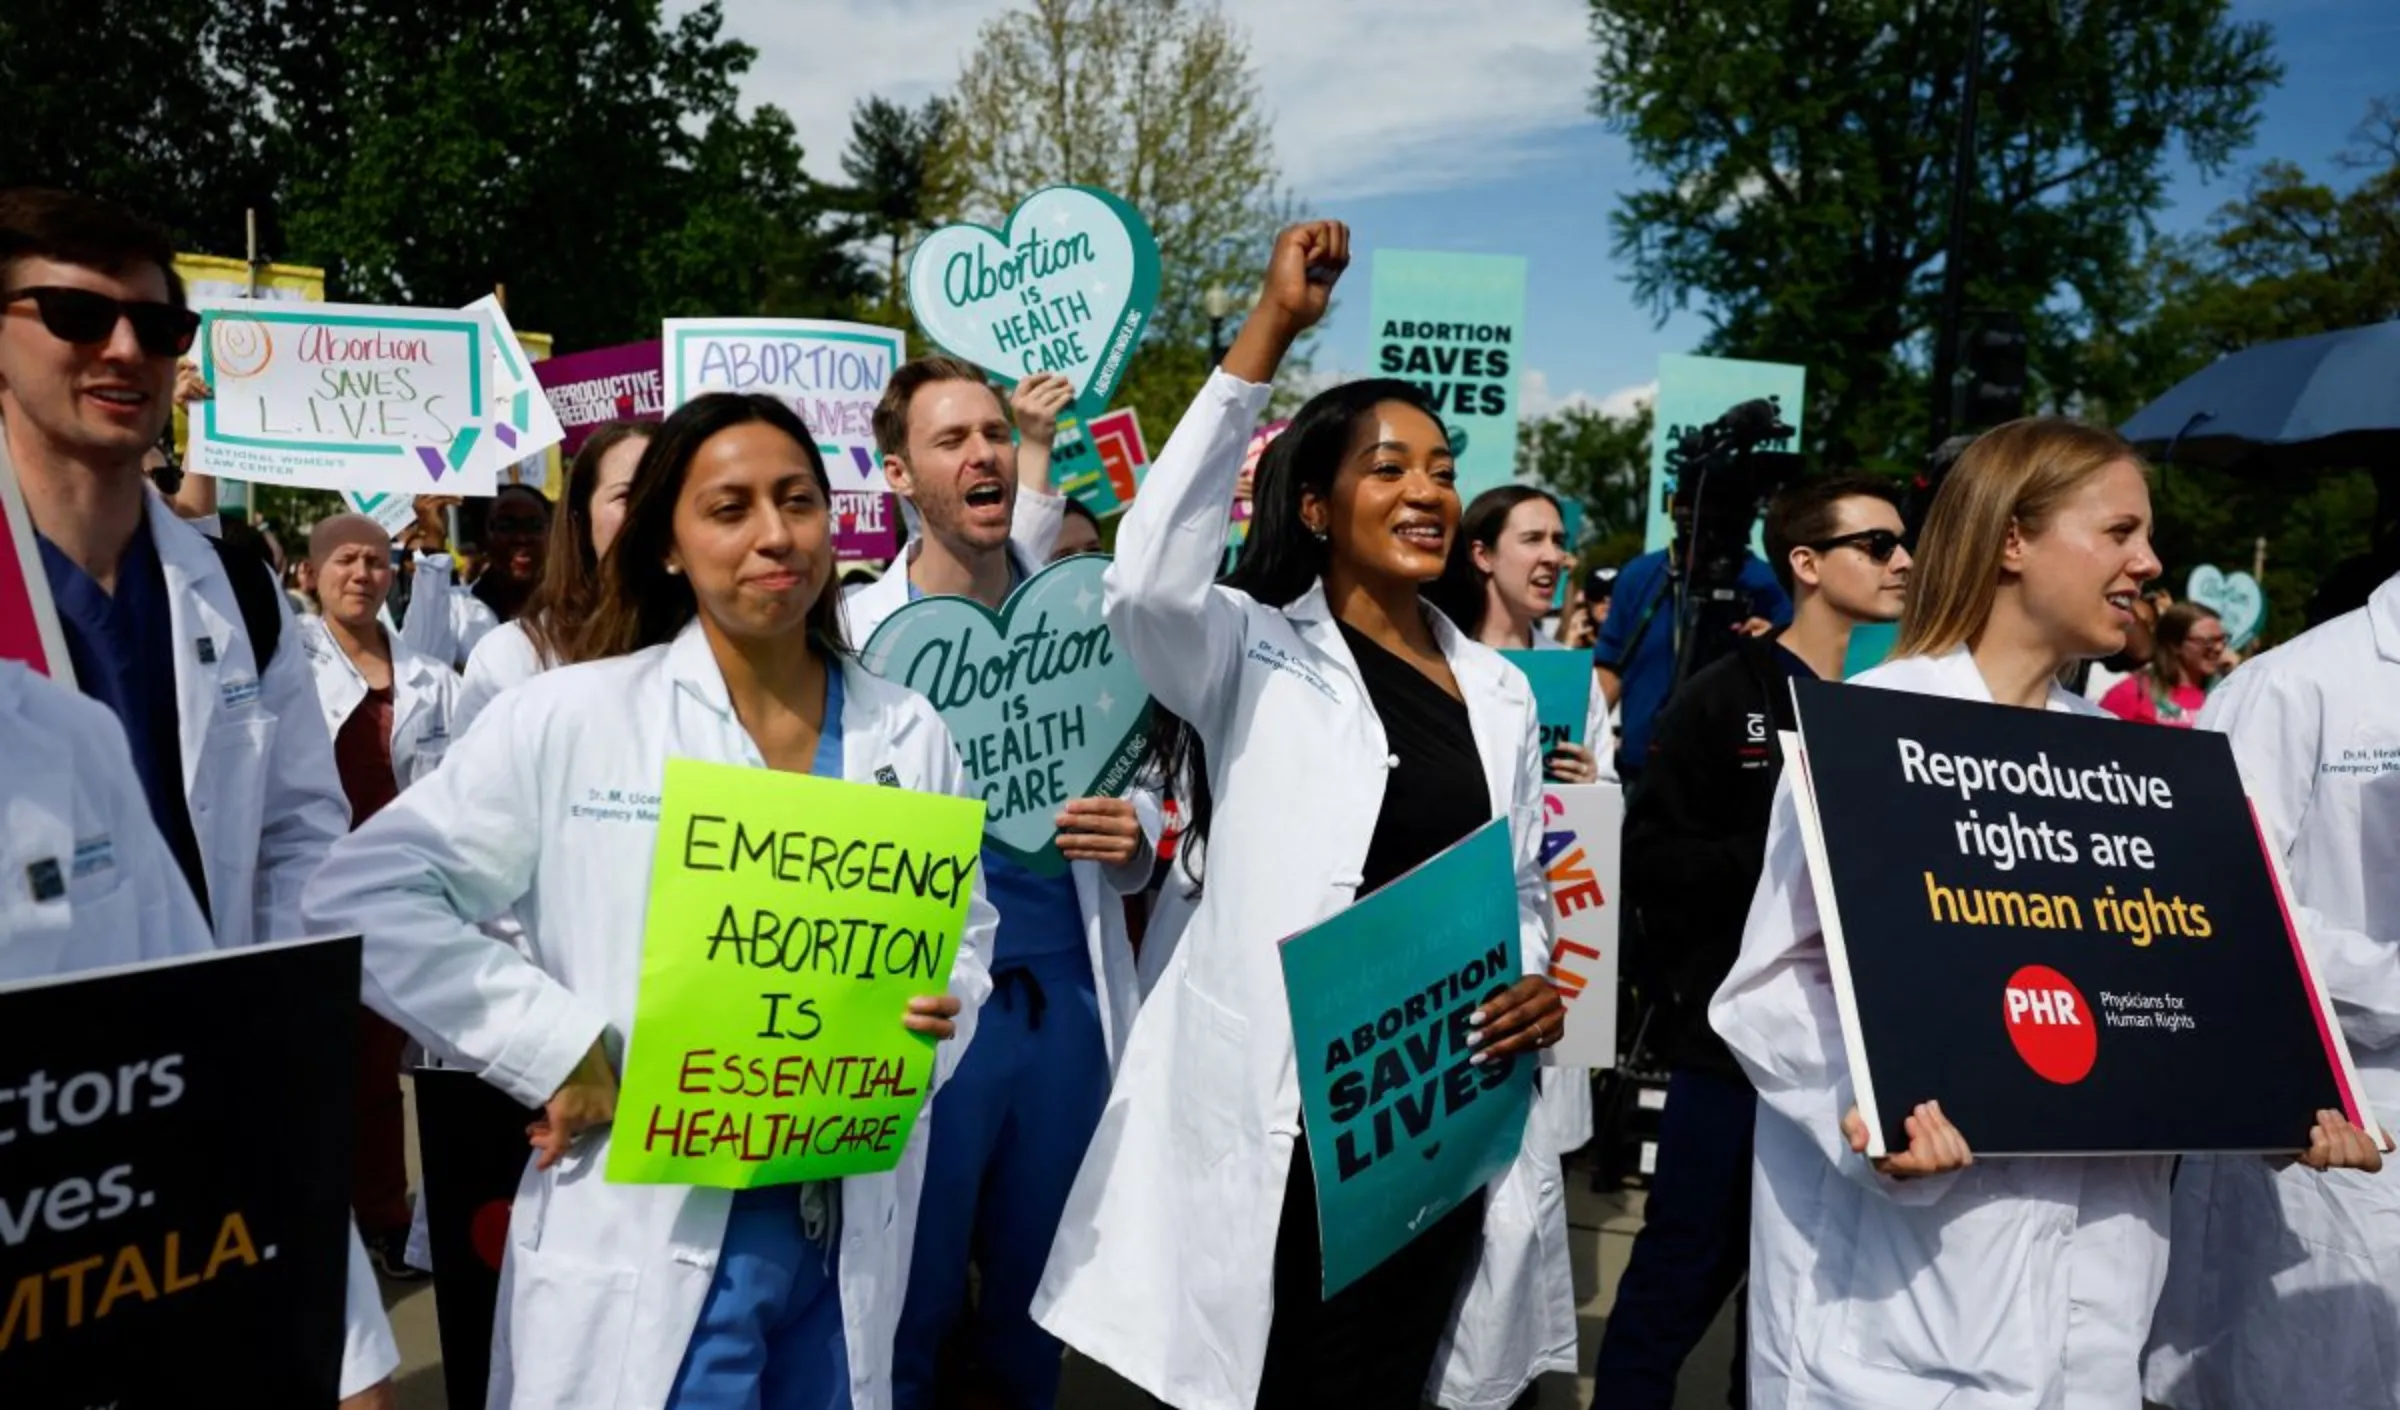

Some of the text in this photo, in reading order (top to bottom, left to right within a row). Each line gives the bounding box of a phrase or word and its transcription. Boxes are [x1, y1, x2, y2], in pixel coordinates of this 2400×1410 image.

[944, 227, 1095, 307] Abortion
[992, 290, 1092, 352] HEALTH
[1020, 286, 1041, 306] IS
[1022, 331, 1088, 376] CARE
[1382, 320, 1512, 343] ABORTION
[315, 367, 417, 400] SAVES
[699, 340, 884, 390] ABORTION
[1380, 344, 1510, 378] SAVES
[634, 389, 664, 415] ALL
[204, 446, 273, 463] NATIONAL
[204, 456, 294, 475] LAW CENTER
[905, 611, 1114, 712] Abortion
[1003, 694, 1029, 723] IS
[956, 704, 1085, 781] HEALTH
[981, 761, 1068, 823] CARE
[1898, 738, 2173, 810] Reproductive
[683, 814, 978, 909] EMERGENCY
[1955, 810, 2155, 871] rights are
[1924, 871, 2211, 947] human rights
[706, 904, 944, 980] ABORTION
[757, 994, 822, 1040] IS
[1325, 941, 1509, 1074] ABORTION
[2006, 987, 2184, 1025] PHR Physicians for
[2105, 1010, 2195, 1032] Human Rights
[0, 1053, 186, 1144] tors
[678, 1049, 917, 1099] ESSENTIAL
[645, 1105, 901, 1161] HEALTHCARE
[0, 1164, 155, 1246] ves.
